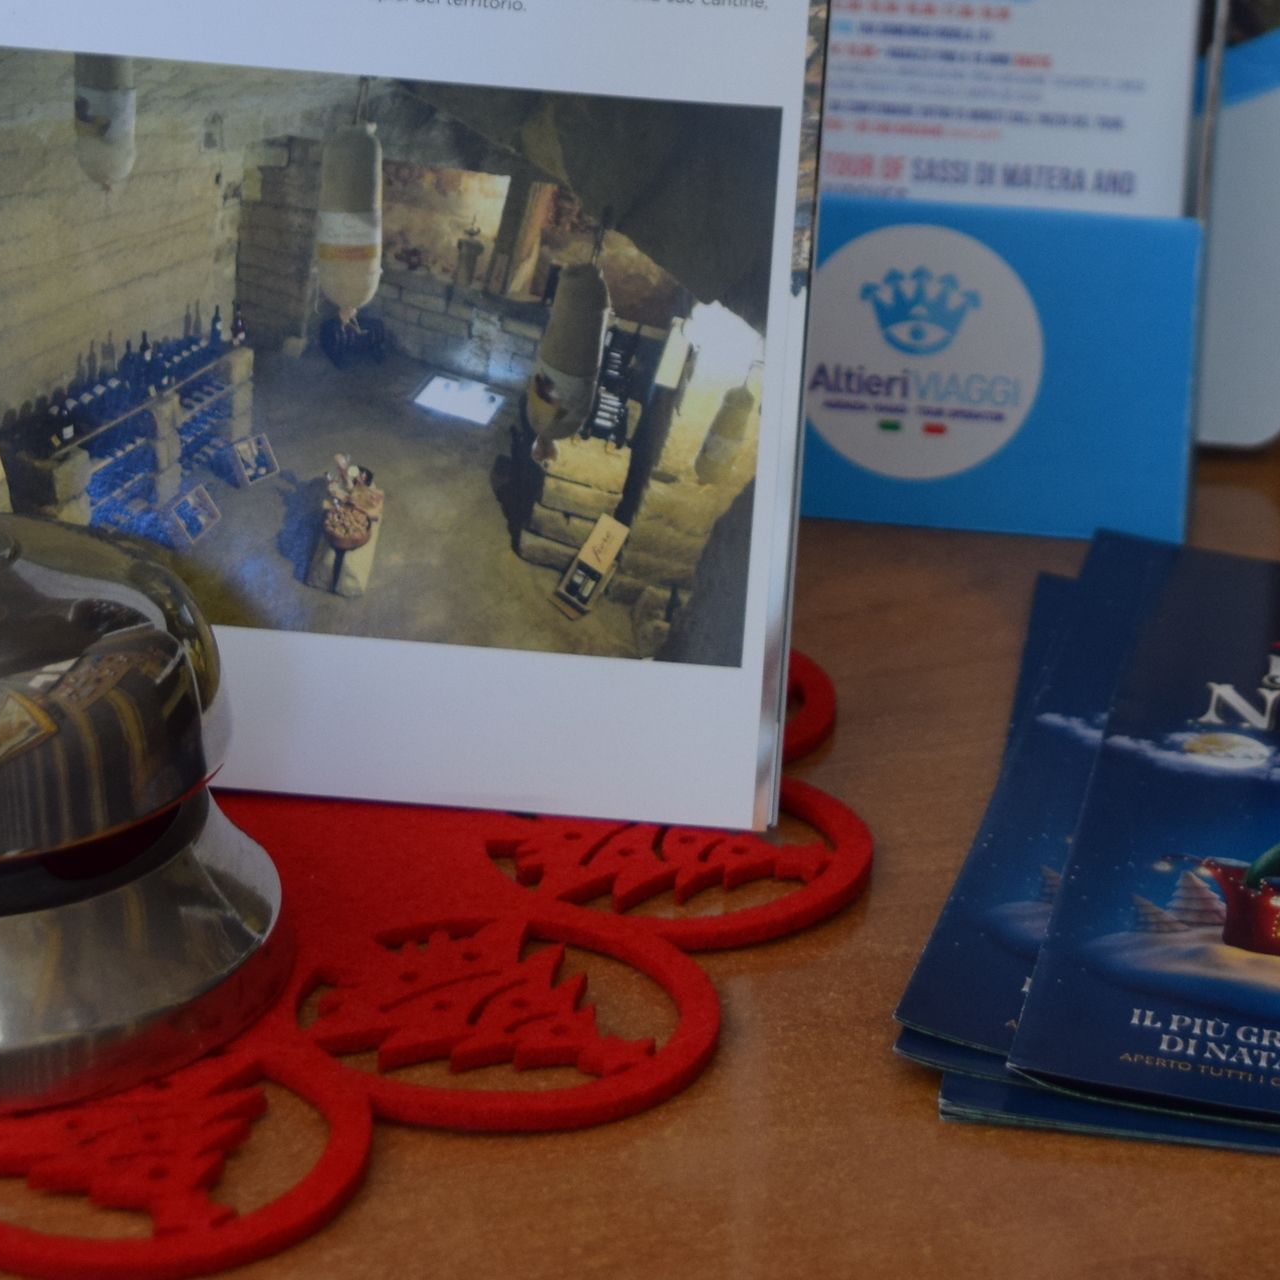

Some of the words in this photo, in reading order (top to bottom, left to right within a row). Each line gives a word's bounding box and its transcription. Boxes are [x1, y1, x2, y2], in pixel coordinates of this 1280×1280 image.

[911, 157, 970, 185] SASSI
[975, 161, 997, 187] DI
[1002, 162, 1088, 193] MATERA
[1091, 169, 1138, 197] AND
[1129, 1007, 1162, 1028] IL
[1169, 1014, 1230, 1039] PIÙ
[1158, 1034, 1197, 1057] DI
[1119, 1052, 1192, 1072] APERTO
[1199, 1064, 1253, 1083] TUTTI
